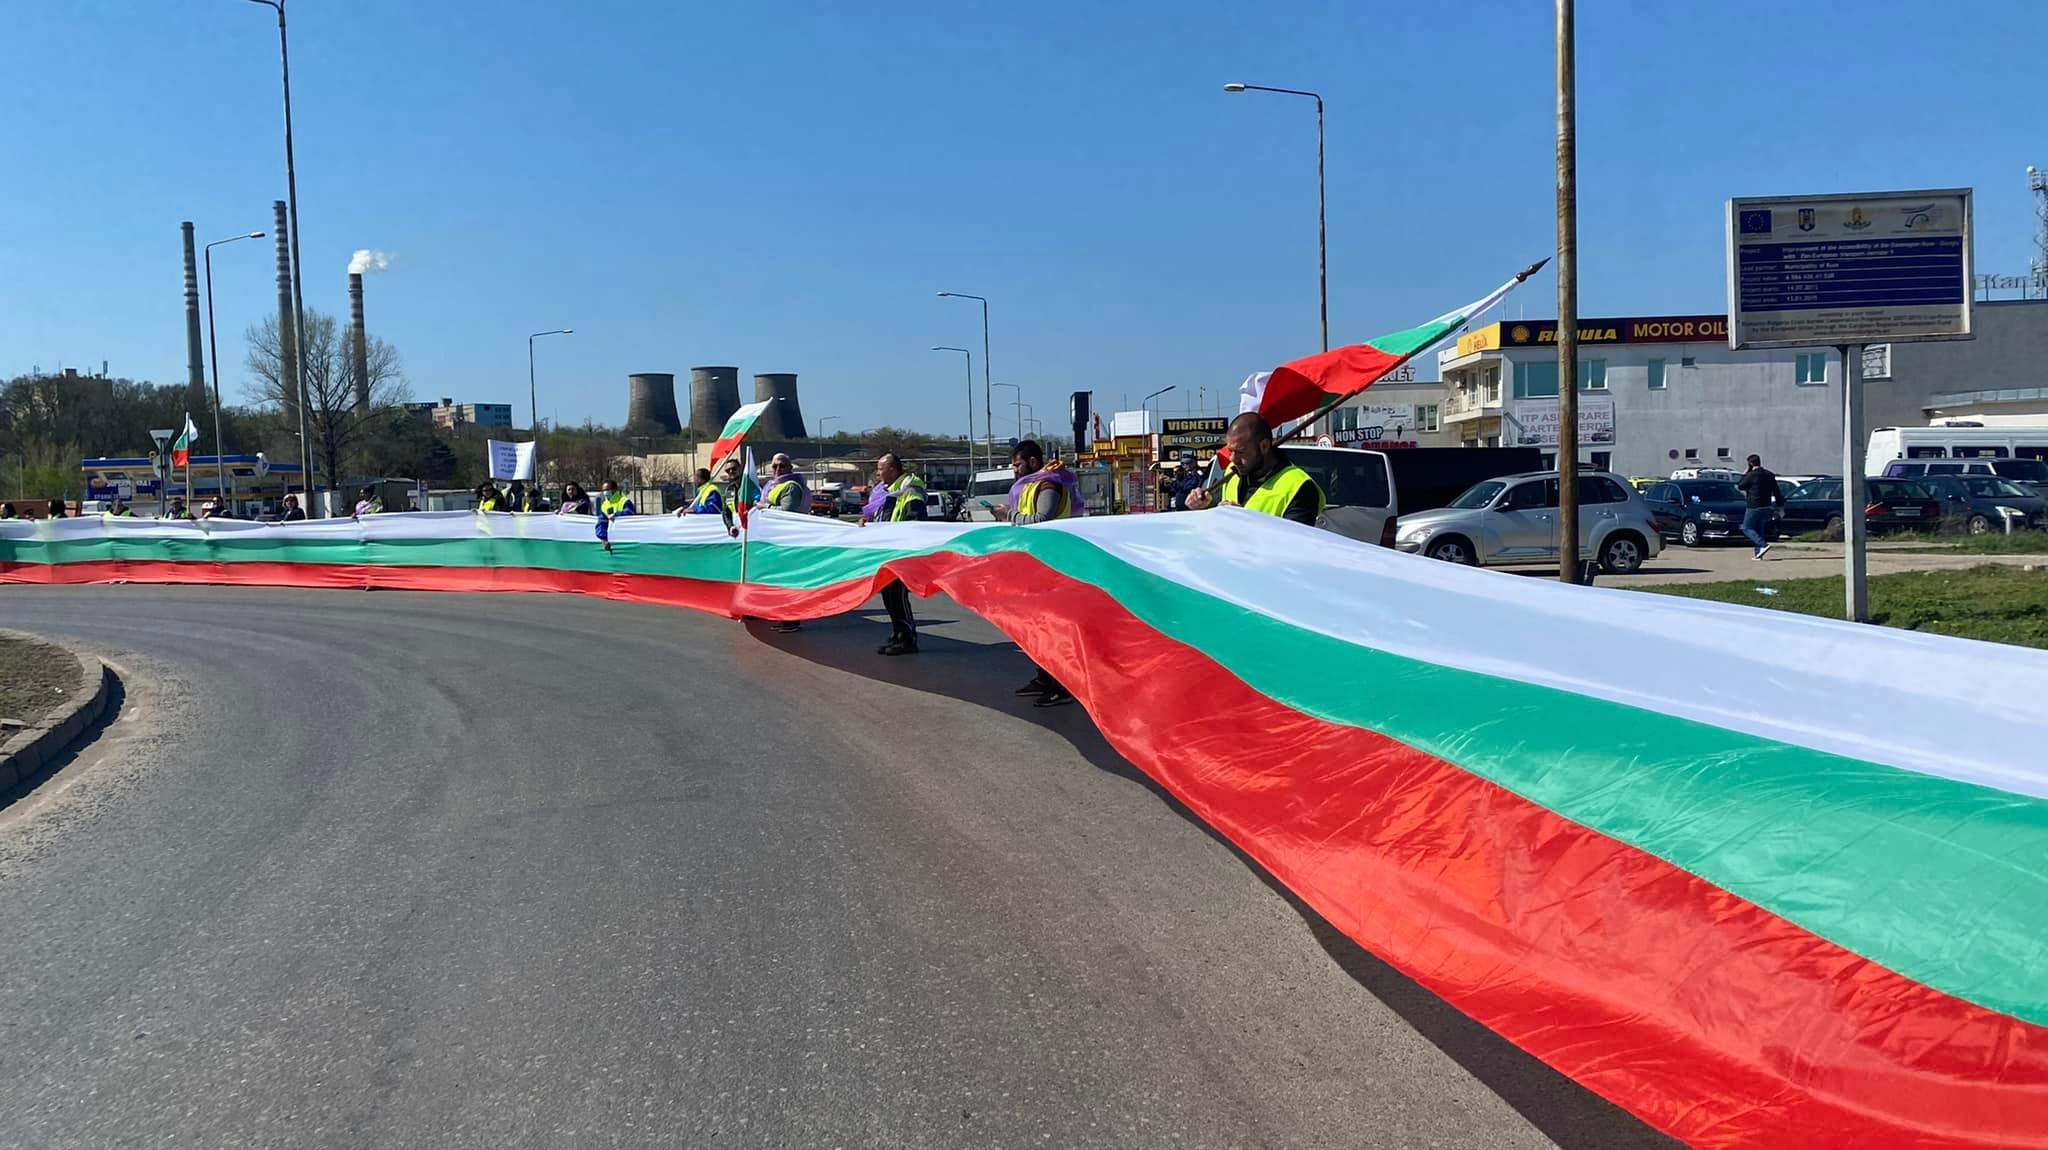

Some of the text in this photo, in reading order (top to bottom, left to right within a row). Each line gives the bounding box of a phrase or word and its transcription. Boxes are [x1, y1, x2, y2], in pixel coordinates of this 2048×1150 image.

[1633, 322, 1694, 337] MOTOR
[1167, 419, 1225, 431] VIGNETTE
[1171, 435, 1220, 444] NON STOP
[1336, 427, 1383, 442] NON STOP
